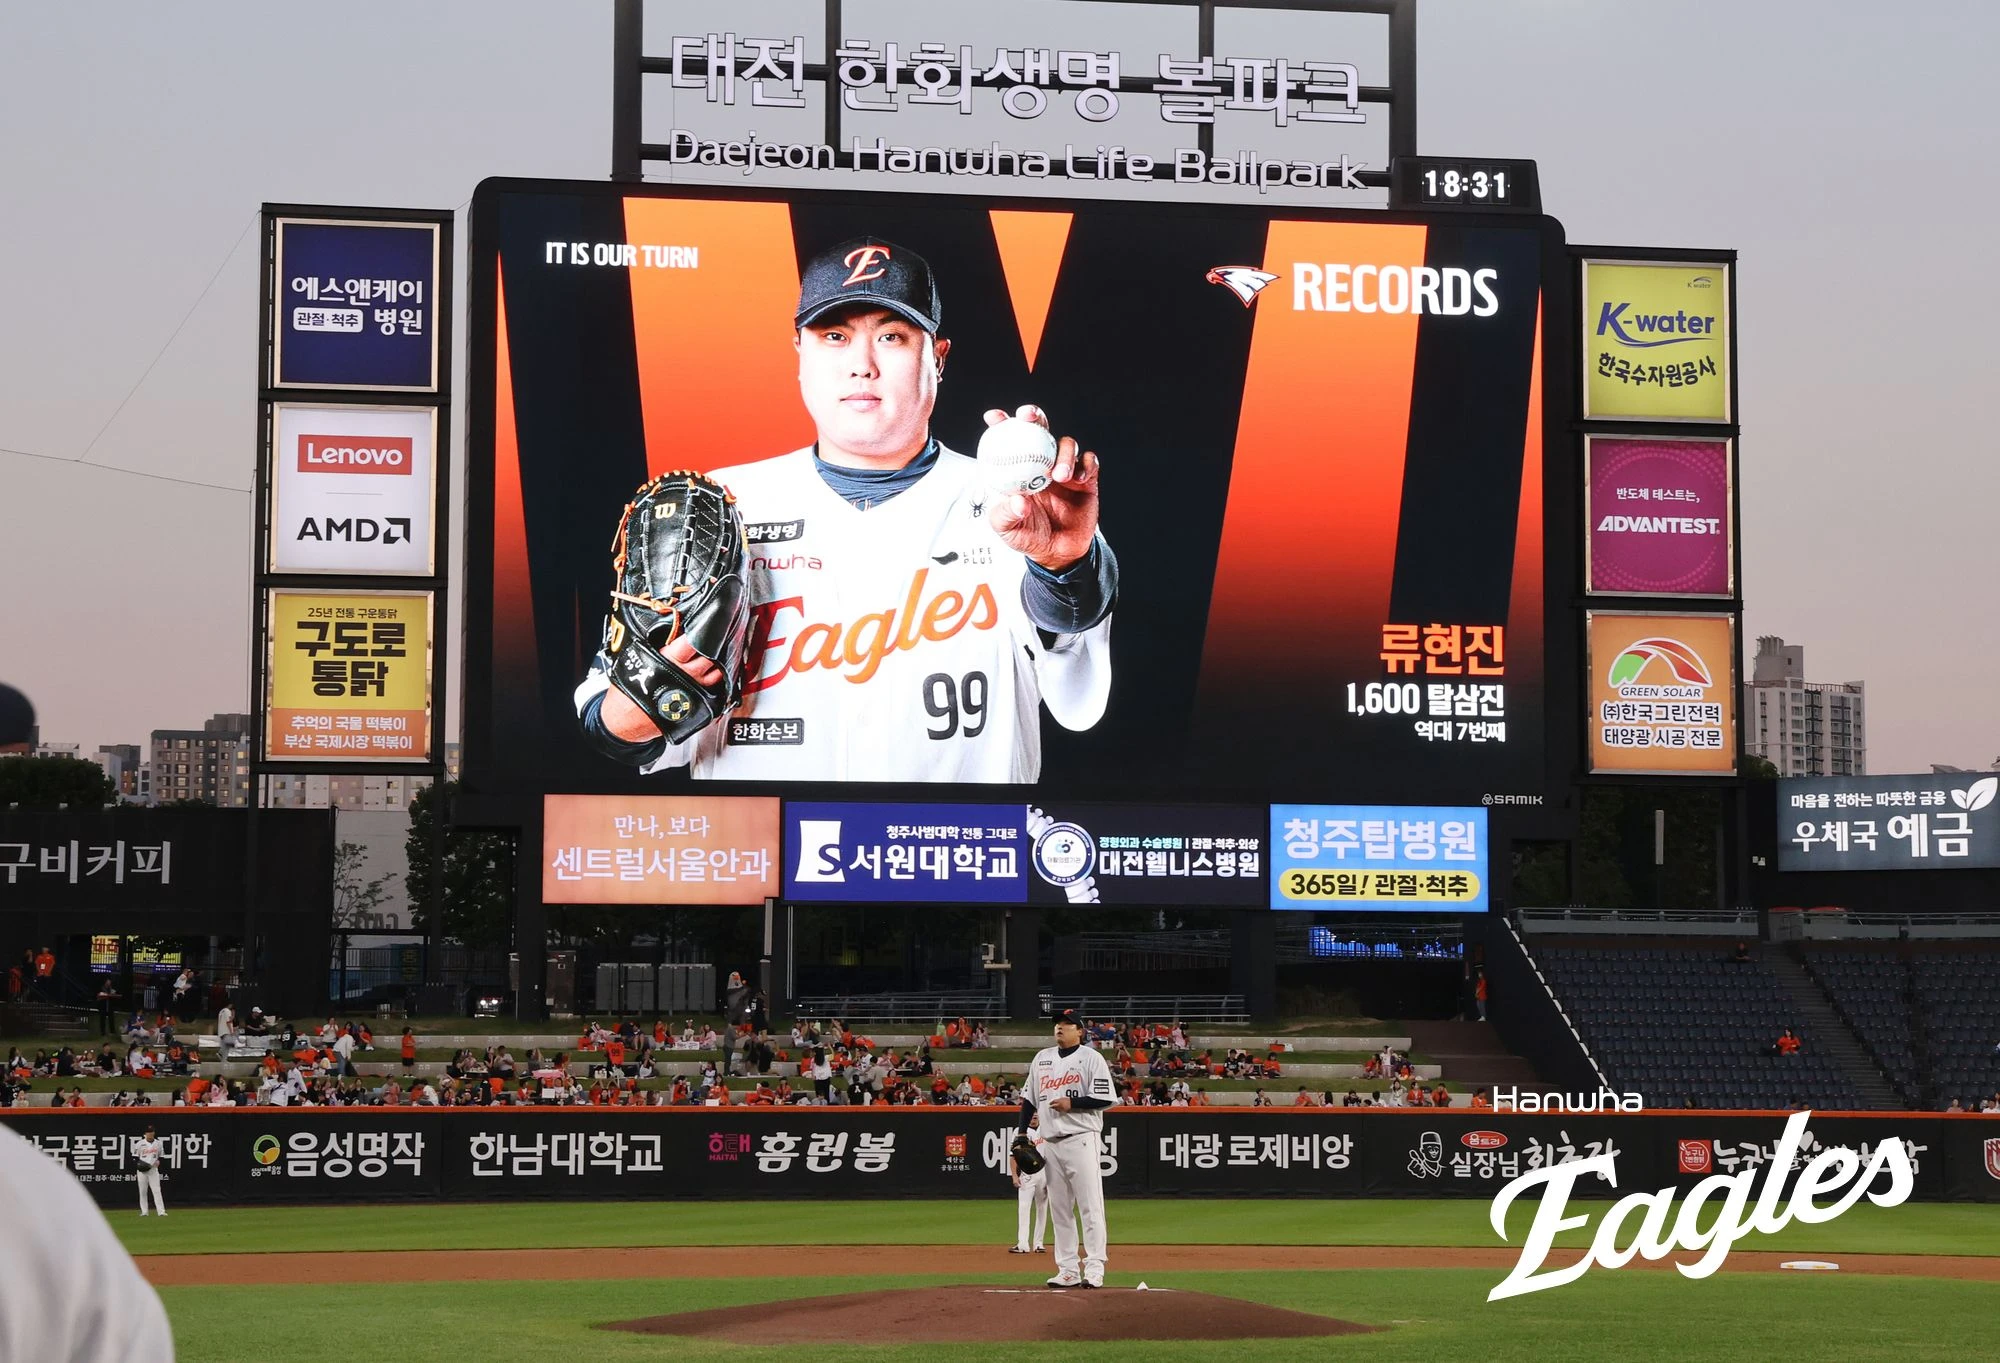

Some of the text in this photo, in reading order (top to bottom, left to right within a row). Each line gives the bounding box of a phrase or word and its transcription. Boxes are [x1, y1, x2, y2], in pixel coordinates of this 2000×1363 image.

[671, 32, 1366, 127] 대전 한화생명 볼파크
[670, 129, 1369, 194] Daejeon Hanwha Life Ballpark
[1424, 169, 1505, 198] 18:31
[546, 241, 699, 269] IT IS OUR TURN
[291, 277, 423, 306] 에스앤케이
[1293, 262, 1499, 317] RECORDS
[297, 312, 359, 327] 관절·척추
[374, 308, 423, 335] 병원
[1597, 302, 1715, 338] K-water
[1598, 352, 1717, 387] 한국수자원공사
[306, 442, 403, 466] Lenovo
[1616, 487, 1701, 503] 반도체 테스트는,
[296, 517, 381, 543] AMD
[745, 523, 798, 540] 화생명
[1597, 515, 1720, 534] ADVANTEST
[308, 608, 333, 618] 25년
[335, 608, 355, 618] 전통
[295, 621, 406, 657] 구도로
[742, 568, 998, 696] Eagles
[1379, 623, 1505, 676] 류현진
[311, 660, 389, 697] 통닭
[1621, 687, 1701, 697] GREEN SOLAR
[922, 670, 989, 740] 99
[1346, 682, 1504, 717] 1,600 탈삼진
[291, 715, 406, 731] 추억의 국물 떡볶이
[732, 722, 800, 742] 한화손보
[1414, 721, 1506, 742] 역대 7번째
[1605, 728, 1720, 746] 태양광 시공 전문
[284, 734, 413, 750] 부산 국제시장 떡볶이
[1494, 794, 1544, 805] SAMIK
[1791, 790, 1946, 808] 마음을 전하는 따뜻한 금융
[886, 825, 1018, 840] 청주사범대학 전통 그대로
[1099, 837, 1140, 849] 정형외과
[1142, 837, 1183, 849] 수술병원
[1283, 818, 1477, 861] 청주탑병원
[1791, 812, 1974, 858] 우체국 예금
[0, 840, 171, 884] 구비커피
[552, 846, 771, 883] 센트럴서울안과
[849, 844, 1019, 881] 서원대학교
[1099, 850, 1260, 878] 대전웰니스병원
[1290, 873, 1469, 897] 365일! 관절·척추
[1040, 1071, 1081, 1094] Eagles
[286, 1132, 425, 1178] 음성명작
[470, 1132, 664, 1176] 한남대학교
[754, 1132, 896, 1173] 홈런볼
[1160, 1133, 1354, 1169] 대광 로제비앙
[1449, 1152, 1519, 1179] 실장님
